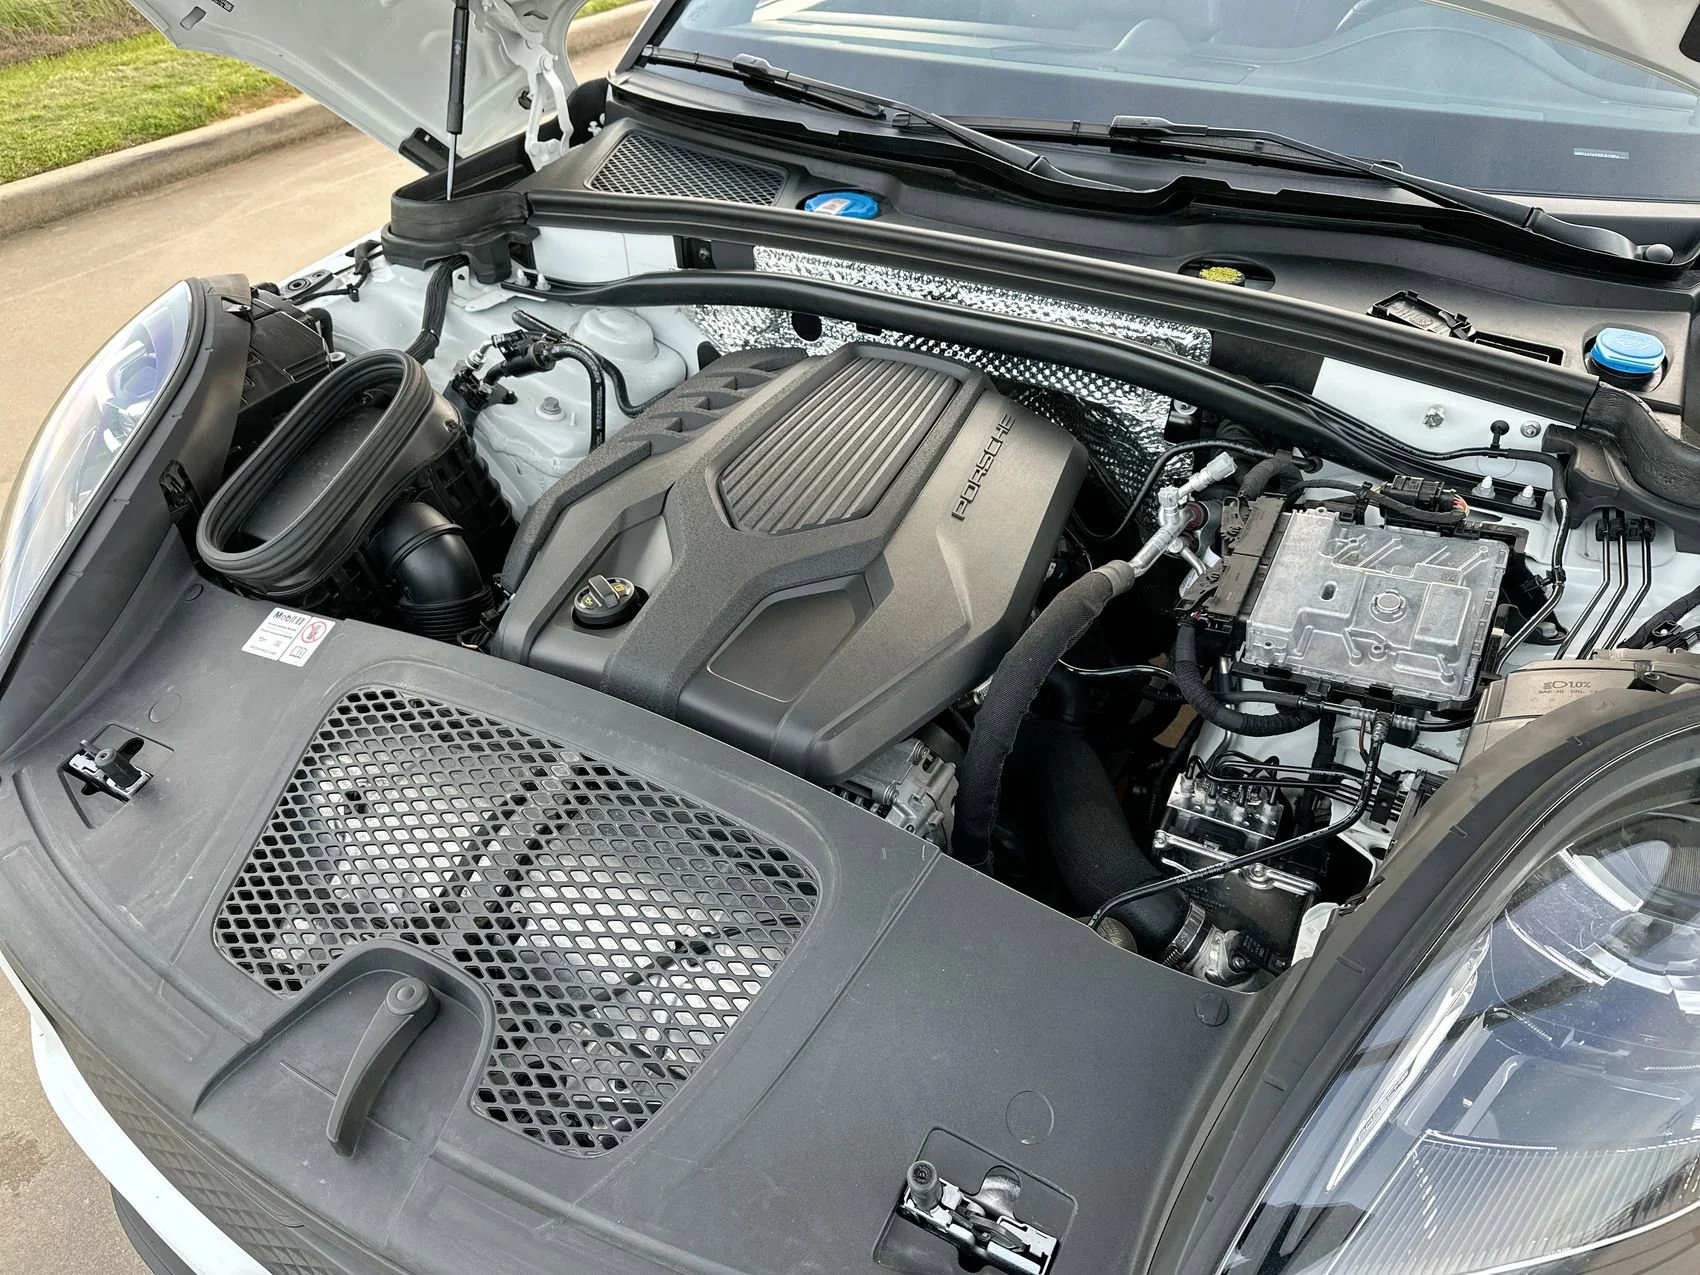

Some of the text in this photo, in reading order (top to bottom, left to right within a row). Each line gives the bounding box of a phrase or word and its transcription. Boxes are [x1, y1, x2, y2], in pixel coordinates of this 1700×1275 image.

[951, 413, 1016, 521] PORSCHE
[273, 611, 298, 624] Mobil
[1568, 681, 1591, 689] 1.0%
